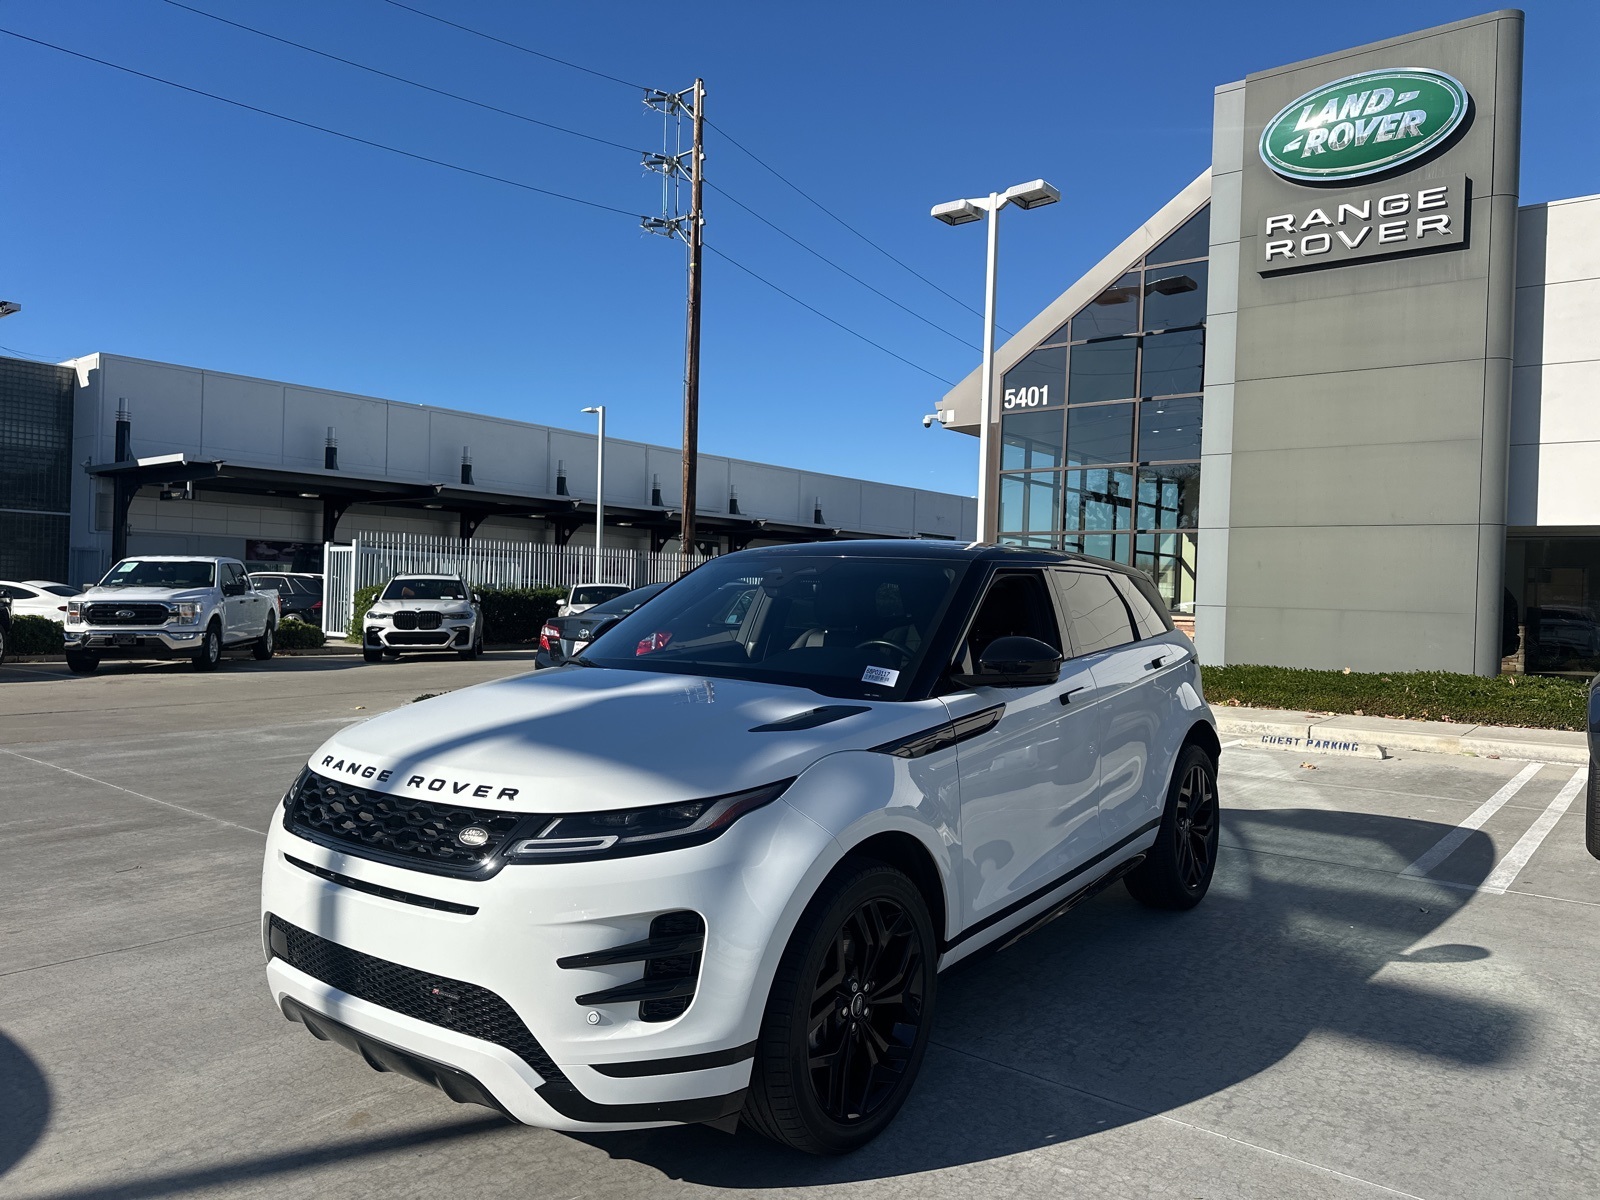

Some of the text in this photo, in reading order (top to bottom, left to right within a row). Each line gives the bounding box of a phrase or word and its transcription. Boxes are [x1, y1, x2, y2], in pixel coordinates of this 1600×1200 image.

[1294, 88, 1394, 132] LAND
[1301, 110, 1427, 158] ROVER
[1266, 186, 1448, 236] RANGE
[1266, 214, 1452, 262] ROVER
[1004, 385, 1048, 409] 5401
[1262, 735, 1359, 751] GUEST PARKING
[321, 755, 519, 801] RANGE ROVER
